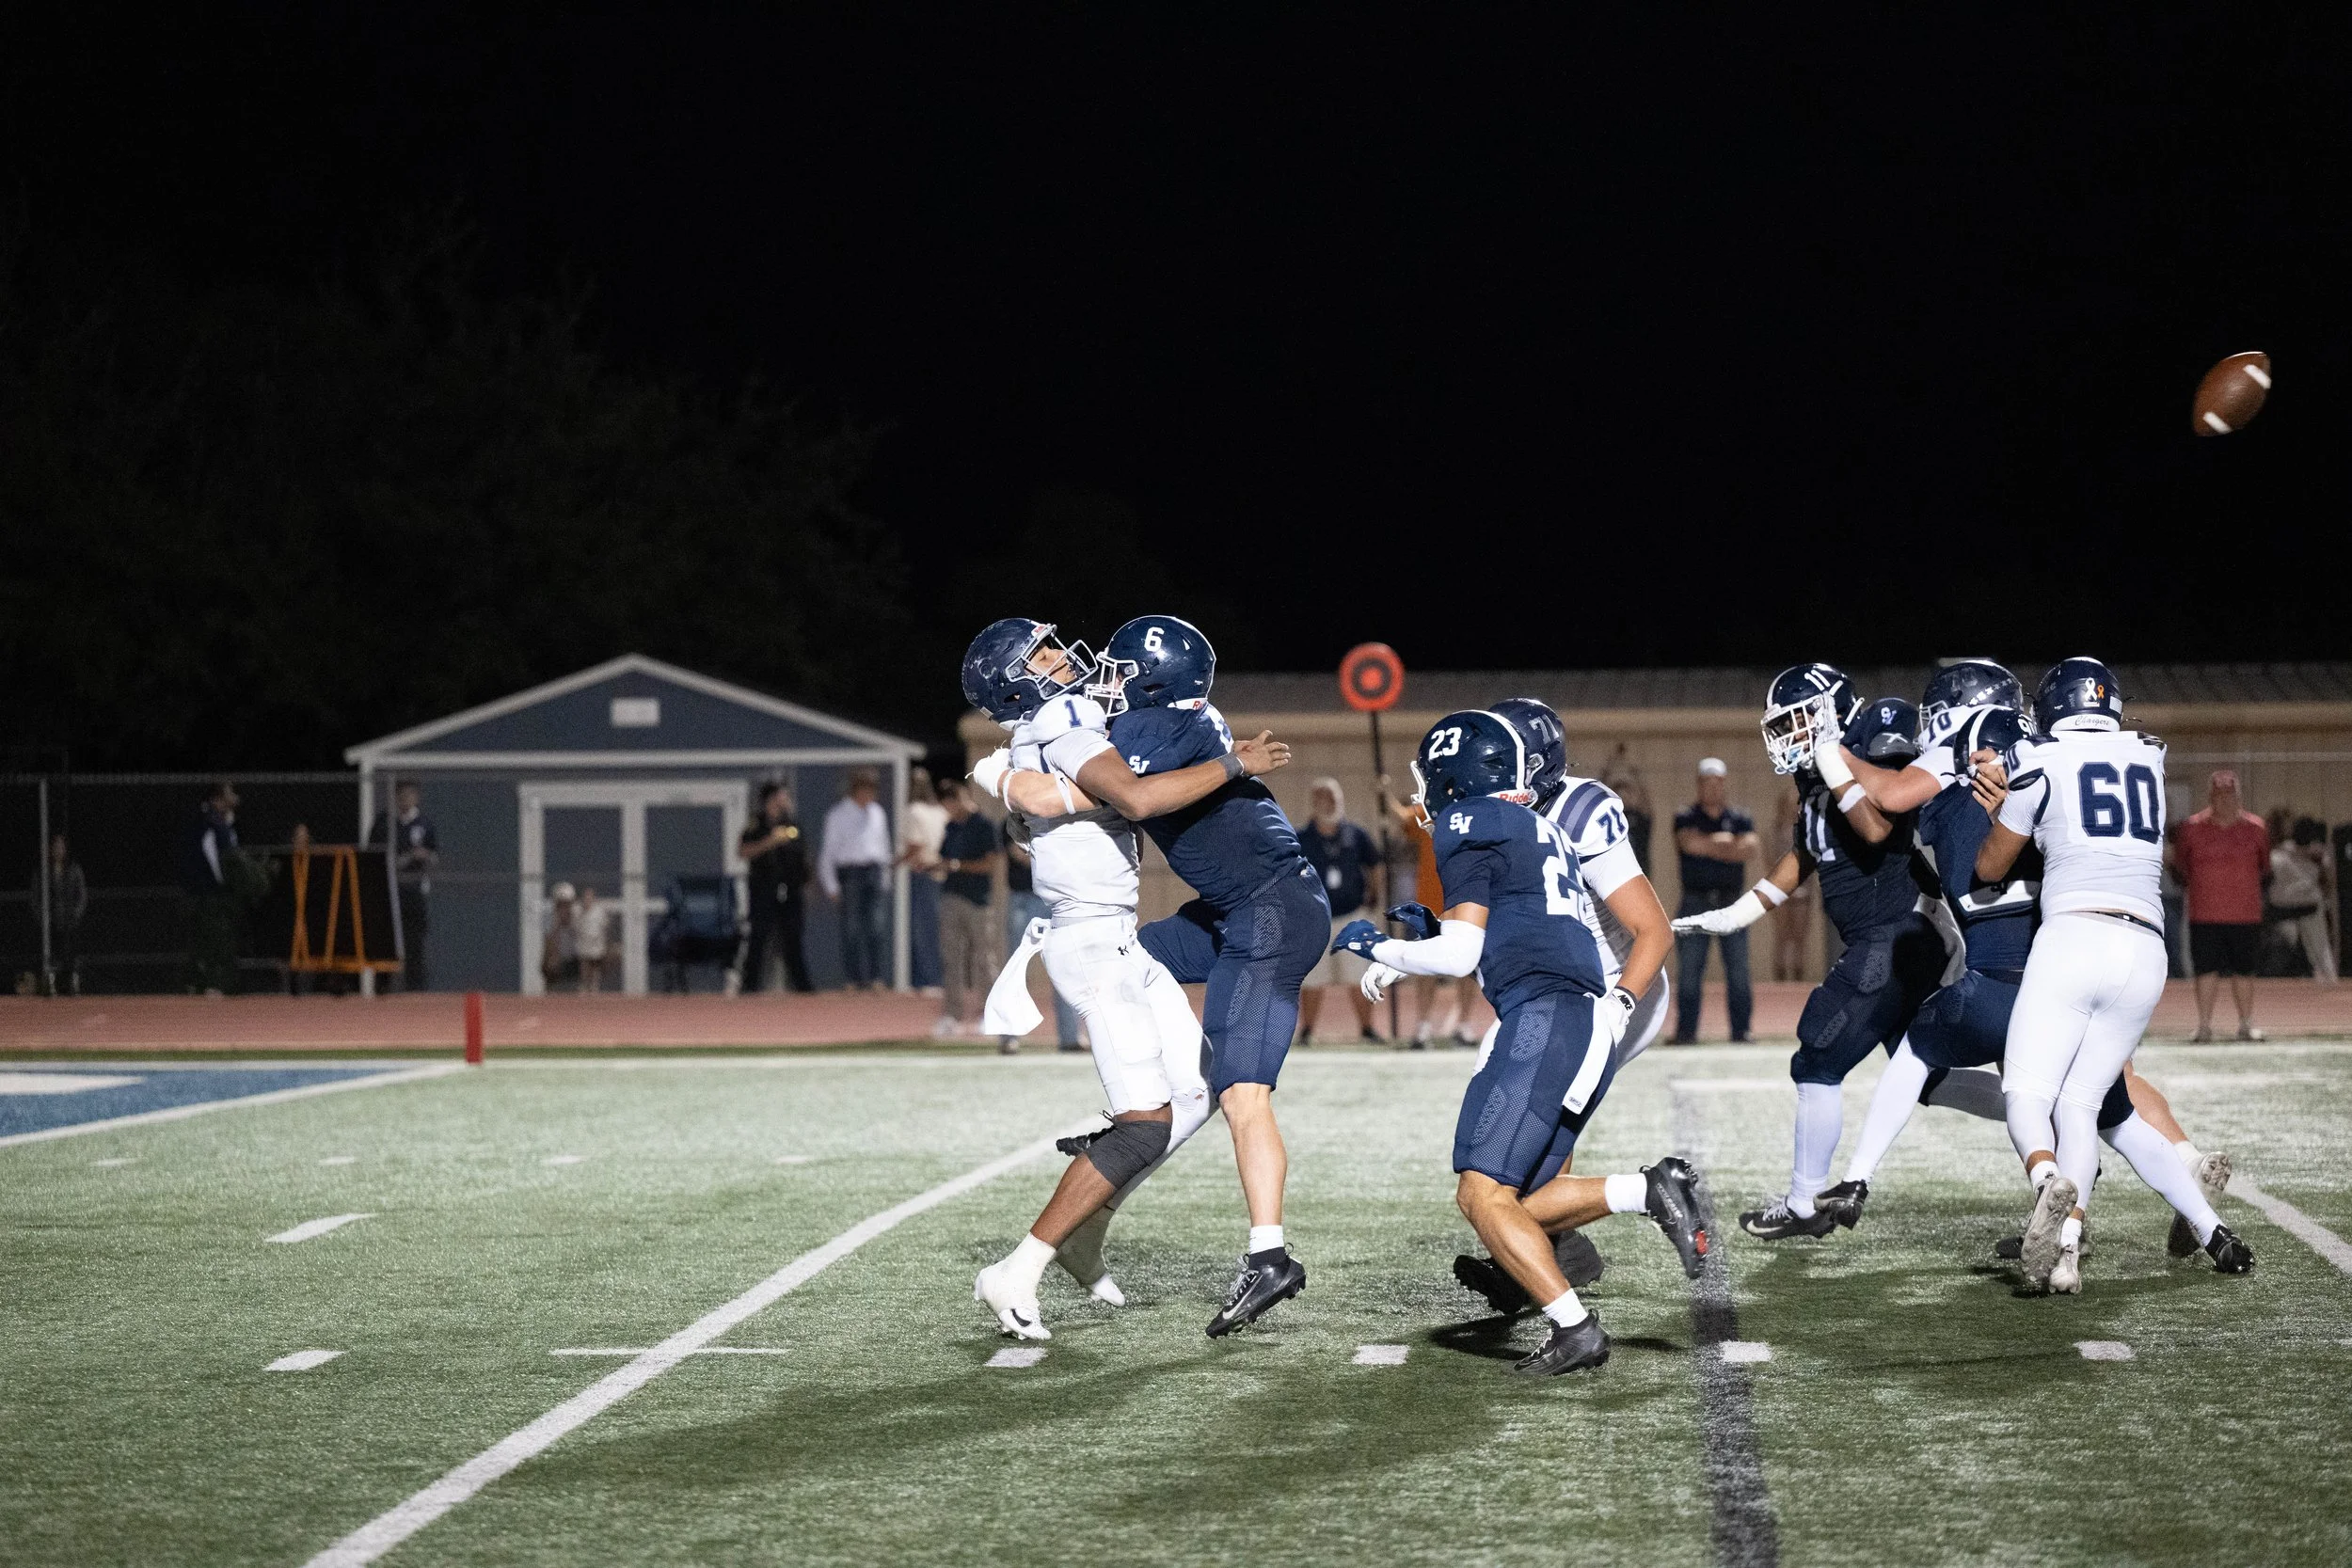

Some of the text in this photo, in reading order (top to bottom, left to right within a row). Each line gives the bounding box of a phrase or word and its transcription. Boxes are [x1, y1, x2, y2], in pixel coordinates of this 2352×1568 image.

[1144, 626, 1165, 652] 6
[1064, 699, 1083, 728] 1
[2074, 715, 2109, 727] Chargers
[1528, 714, 1560, 745] 71
[1428, 726, 1462, 761] 23
[1129, 755, 1151, 775] SV
[1499, 792, 1530, 803] Ridde
[2077, 761, 2161, 845] 60
[1449, 812, 1473, 834] SV
[1596, 805, 1627, 847] 71
